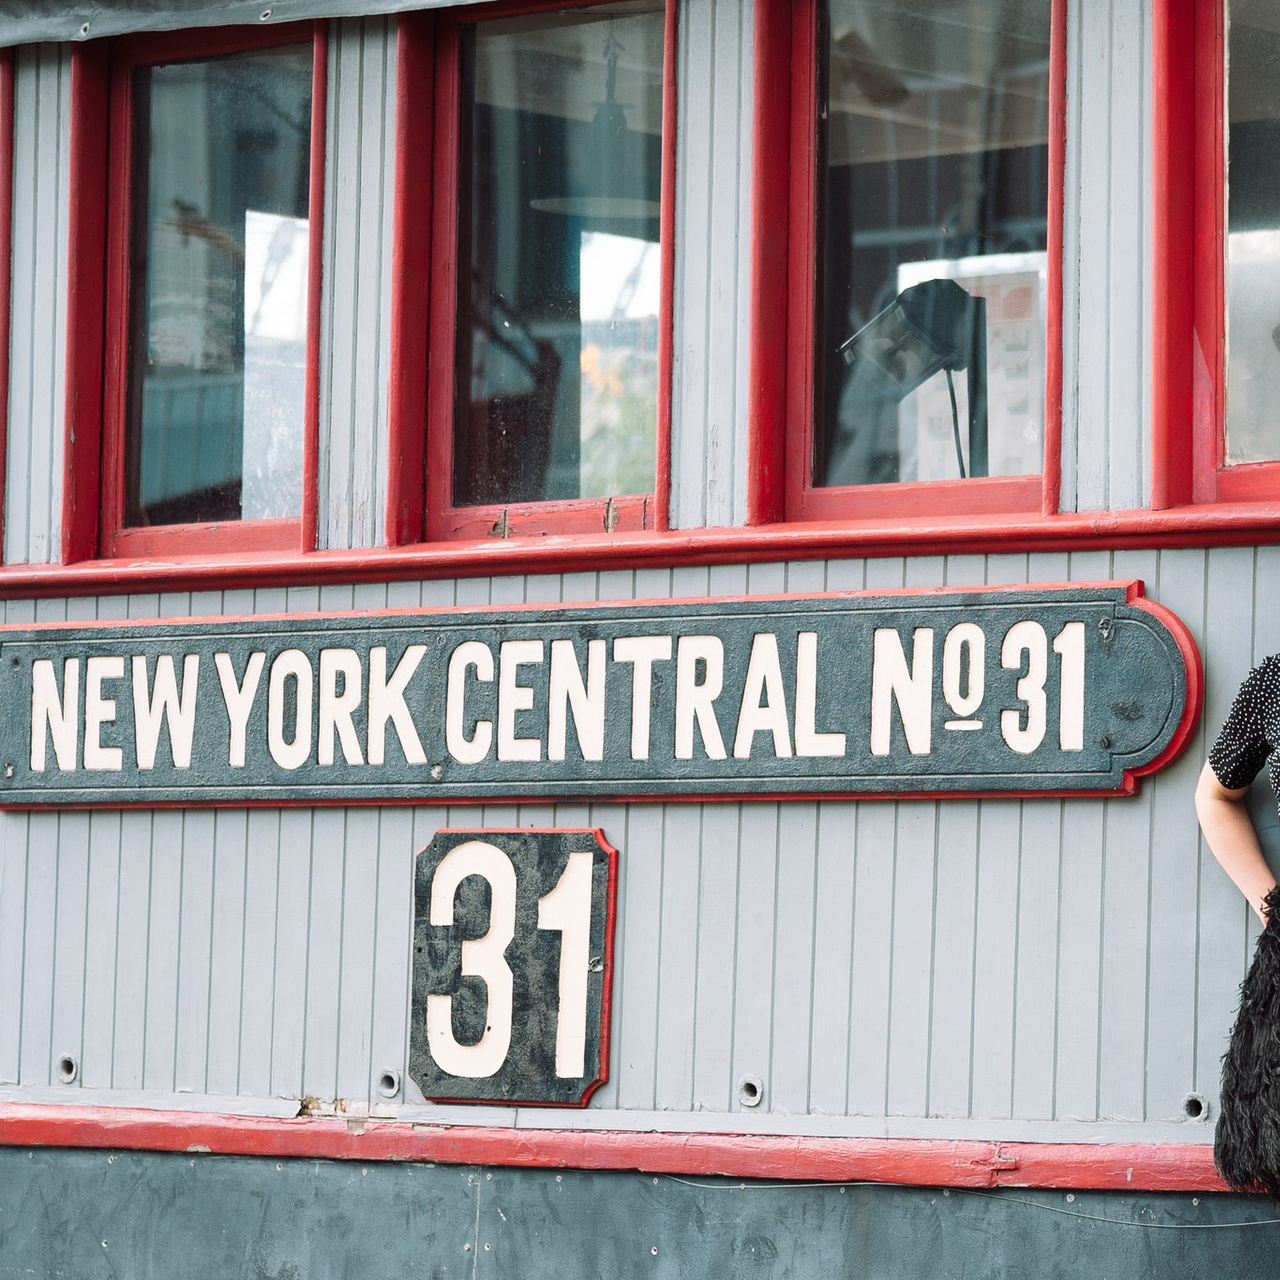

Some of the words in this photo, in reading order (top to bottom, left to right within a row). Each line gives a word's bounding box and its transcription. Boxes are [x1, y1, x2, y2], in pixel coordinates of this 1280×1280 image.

[30, 654, 200, 773] NEW
[214, 645, 428, 770] YORK
[446, 632, 847, 766] CENTRAL
[1000, 620, 1086, 756] 31
[426, 840, 594, 1080] 31
